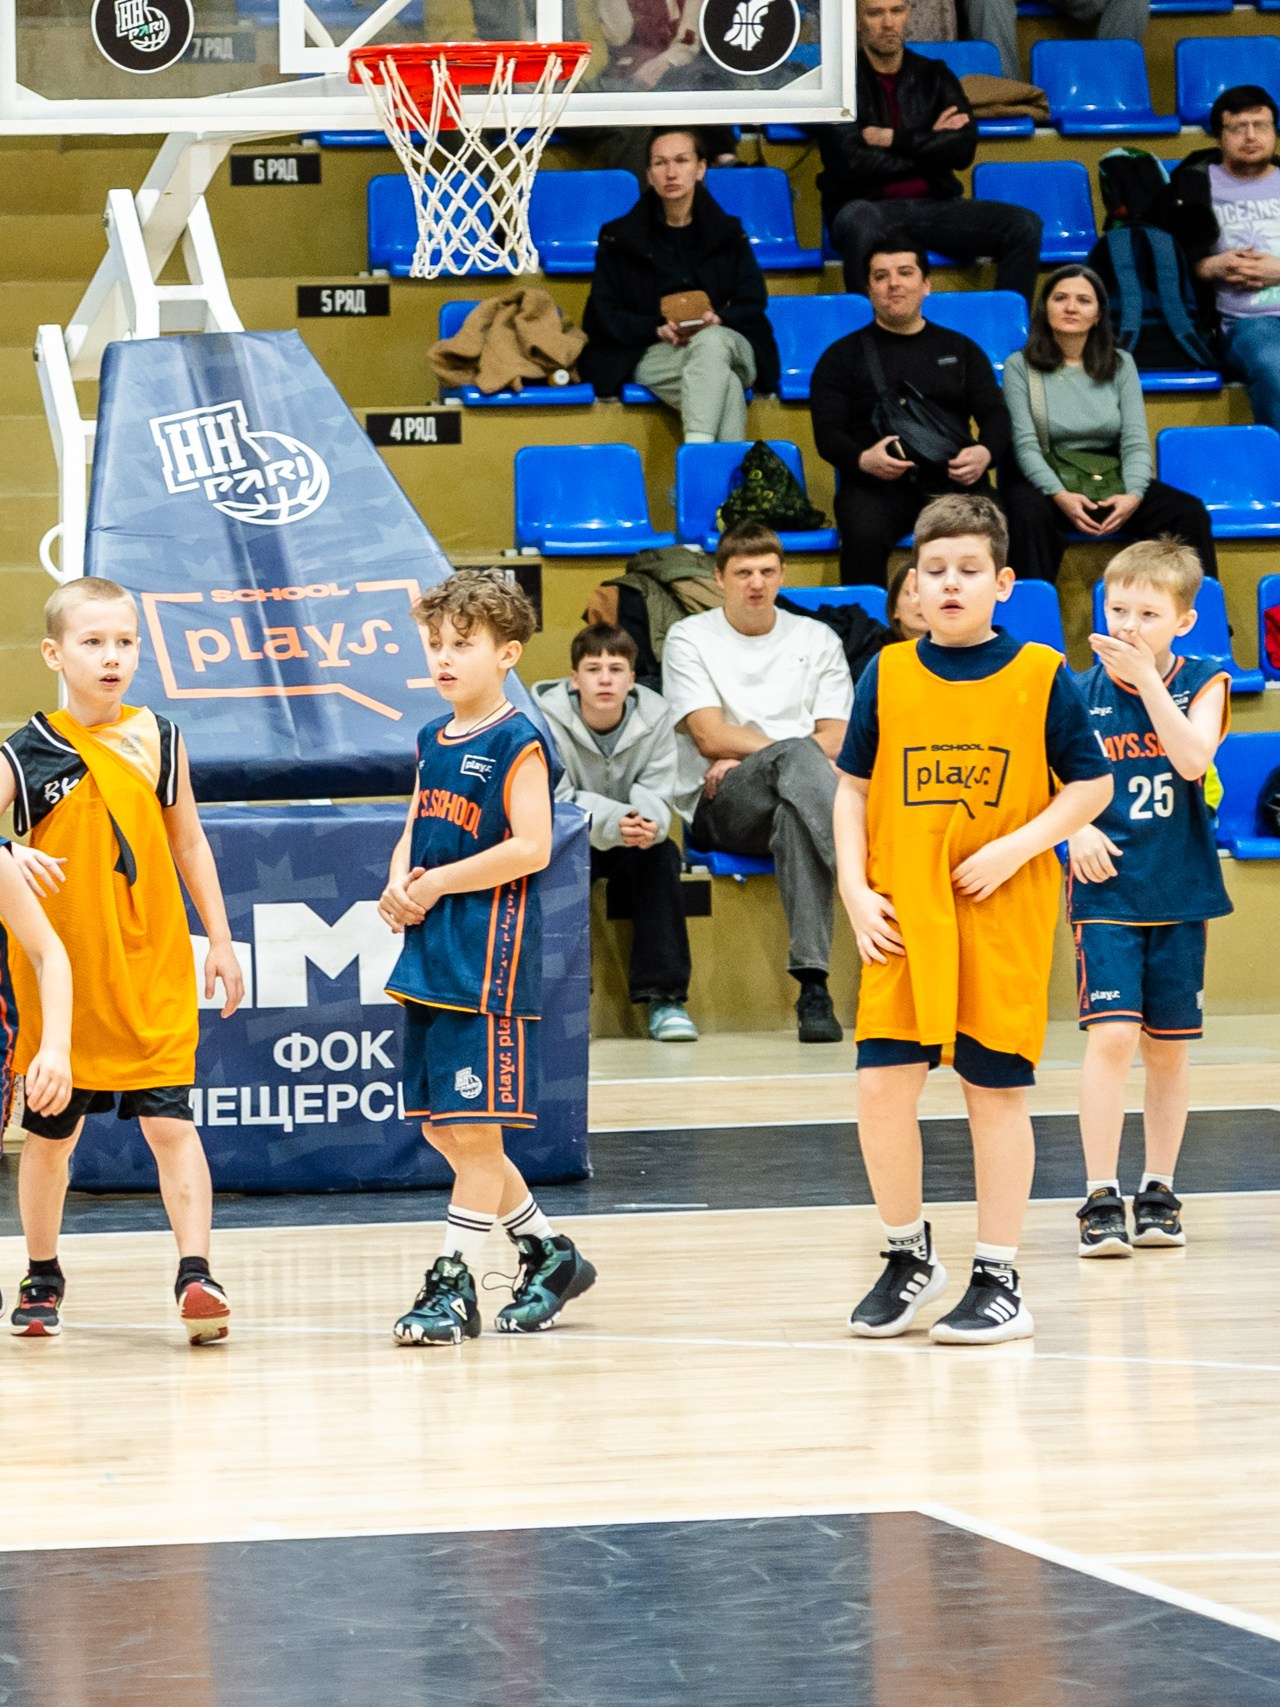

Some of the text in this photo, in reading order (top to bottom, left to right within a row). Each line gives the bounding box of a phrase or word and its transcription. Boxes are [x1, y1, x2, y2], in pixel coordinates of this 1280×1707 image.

[203, 36, 234, 60] РЯД
[253, 158, 299, 182] 6 РЯД
[321, 289, 367, 314] 5 РЯД
[389, 417, 438, 443] 4 РЯД
[211, 582, 351, 603] SCHOOL
[184, 617, 401, 673] plays.
[931, 743, 985, 751] SCHOOL
[916, 760, 991, 792] plays.
[1128, 772, 1175, 821] 25
[272, 1029, 396, 1073] ФОК
[188, 1081, 405, 1133] ЕЩЕРС
